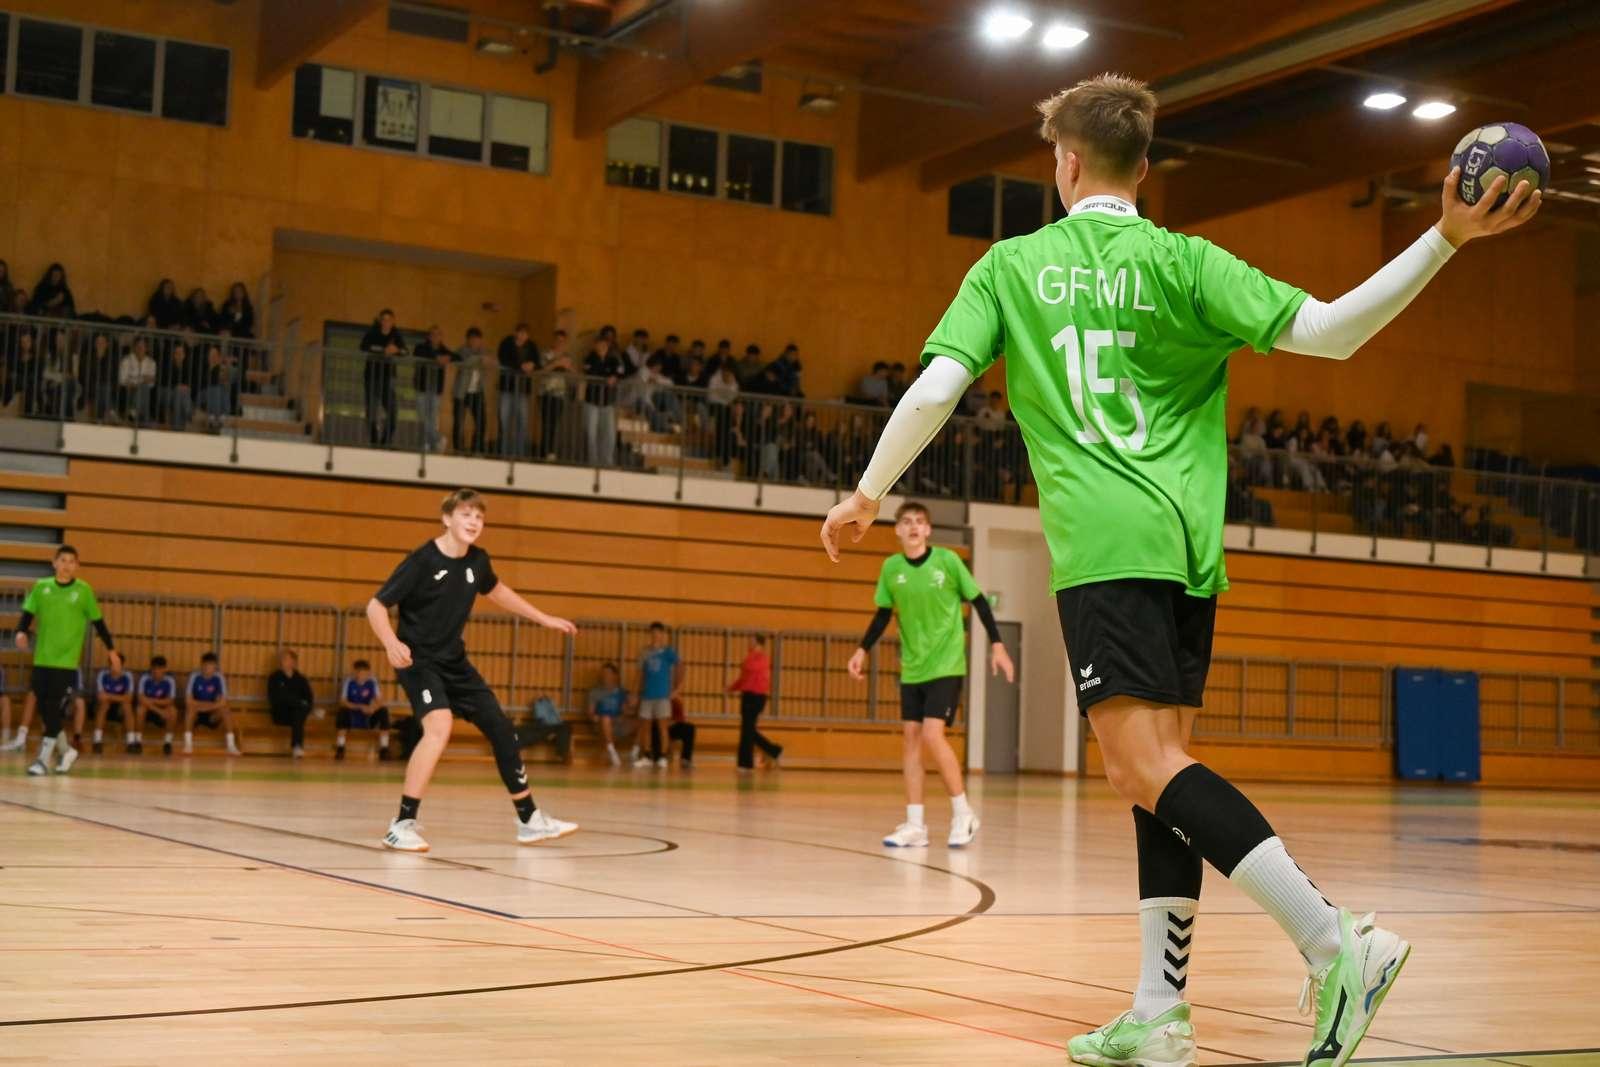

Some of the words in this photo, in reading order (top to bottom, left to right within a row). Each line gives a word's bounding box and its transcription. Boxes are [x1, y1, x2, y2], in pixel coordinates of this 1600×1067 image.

[1462, 146, 1488, 204] SELECT
[1082, 201, 1128, 213] ARMOUR
[1037, 265, 1156, 312] GFML
[1050, 324, 1147, 451] 15
[1079, 677, 1101, 691] erima
